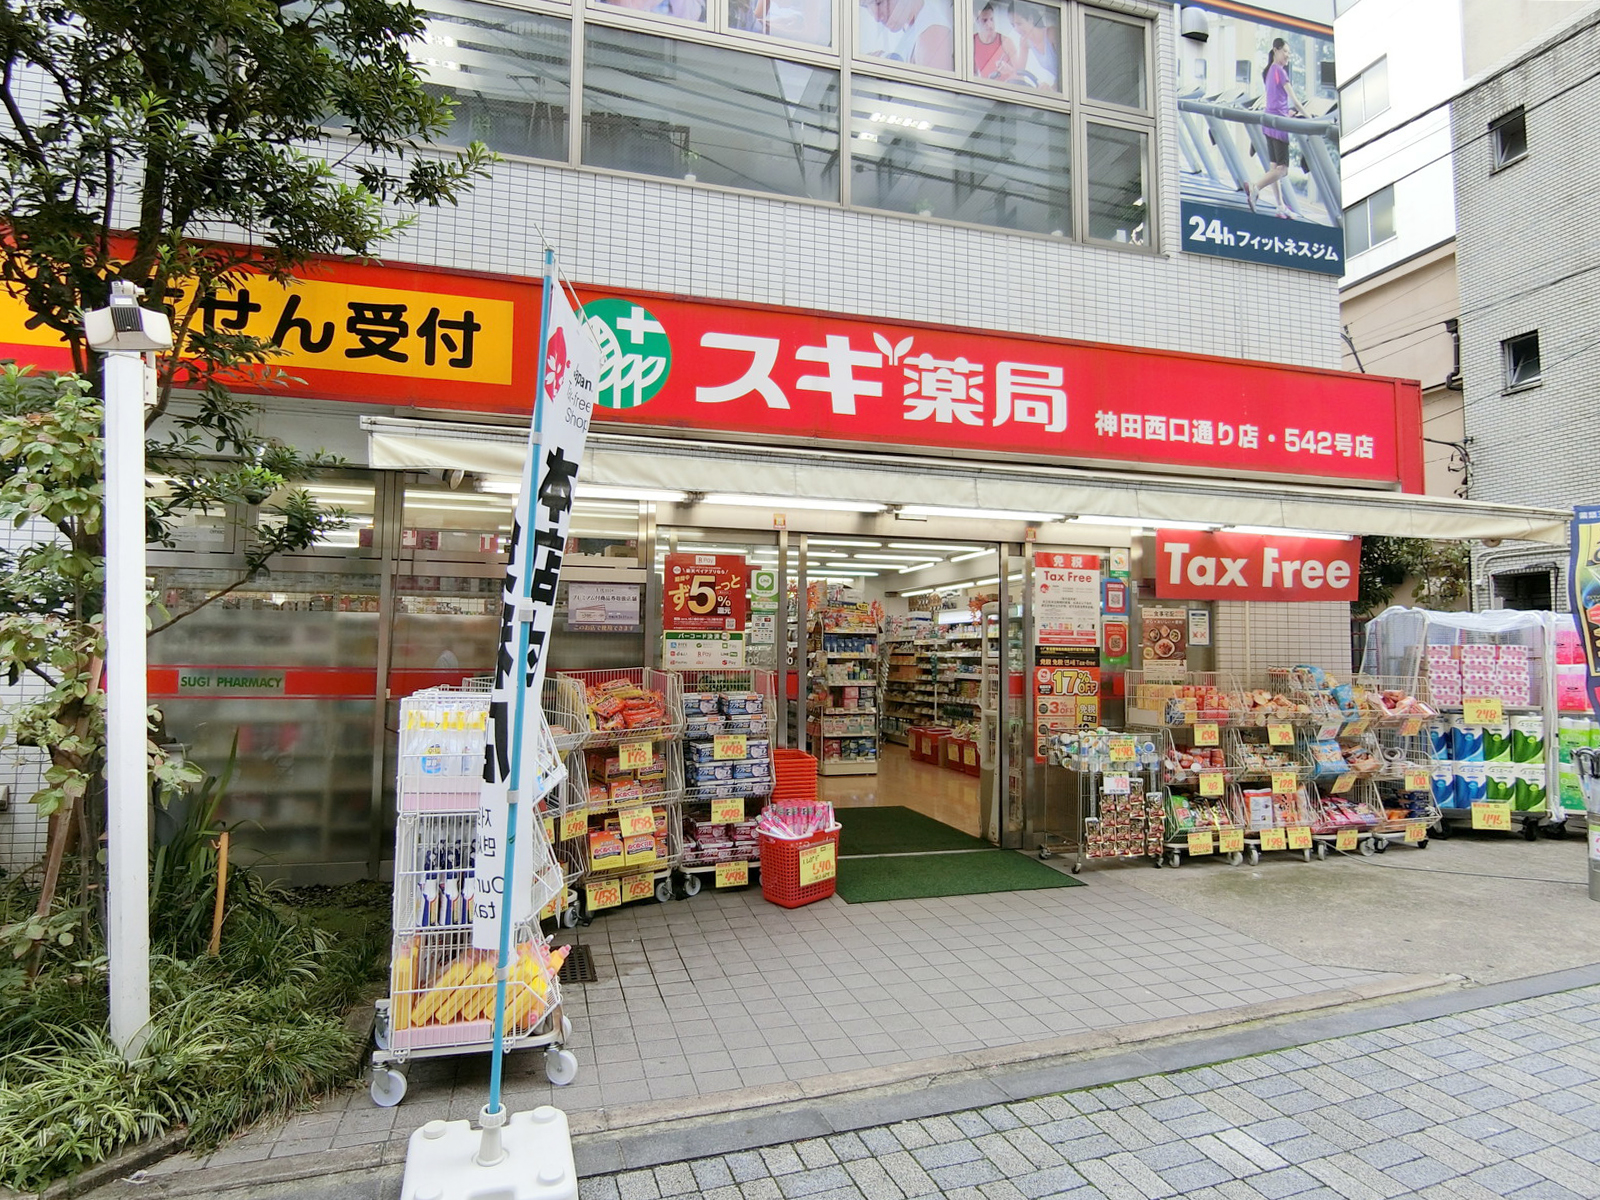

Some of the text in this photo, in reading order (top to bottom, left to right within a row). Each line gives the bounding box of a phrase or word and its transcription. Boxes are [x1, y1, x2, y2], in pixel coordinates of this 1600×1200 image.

[695, 332, 1067, 433] スギ薬局
[565, 407, 588, 433] Shop
[1044, 571, 1092, 582] Tax Free
[1164, 542, 1351, 590] Tax Free
[687, 575, 716, 614] 5
[180, 676, 282, 688] SUGI PHARMACY
[1078, 682, 1097, 694] OFF
